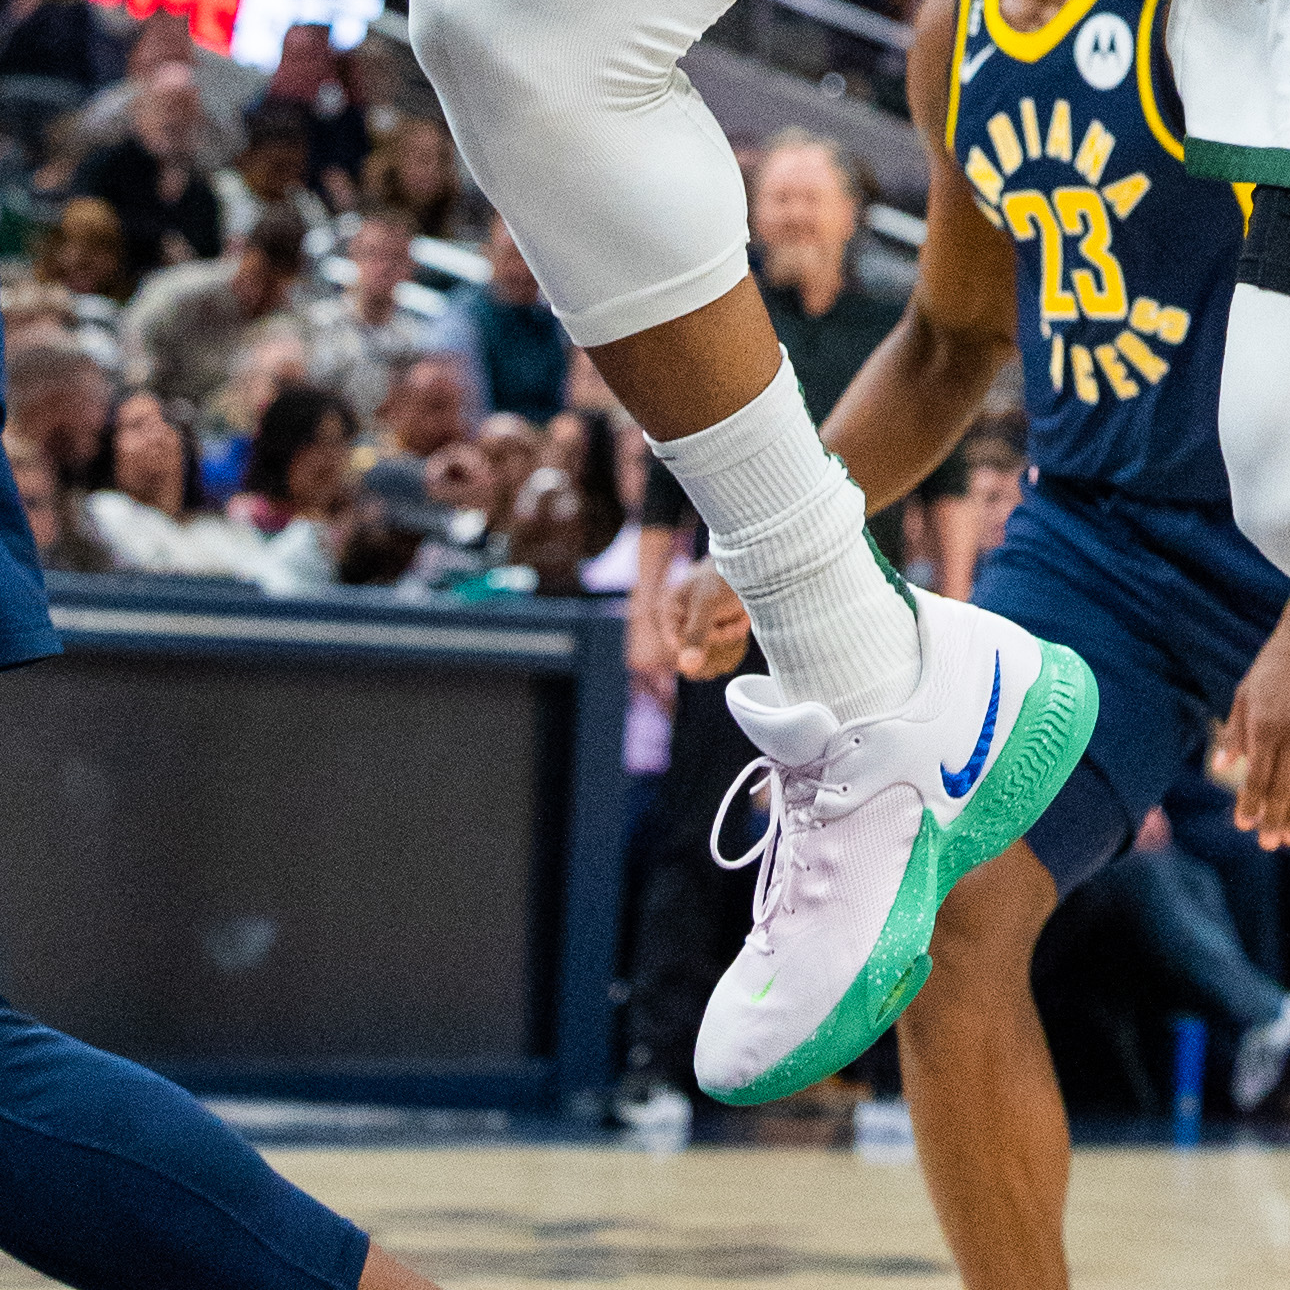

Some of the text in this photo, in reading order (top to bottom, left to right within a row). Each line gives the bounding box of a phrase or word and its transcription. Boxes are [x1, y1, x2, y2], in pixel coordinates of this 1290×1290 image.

[966, 96, 1152, 229] INDIANA
[1001, 185, 1129, 321] 23
[1040, 296, 1191, 406] CERS
